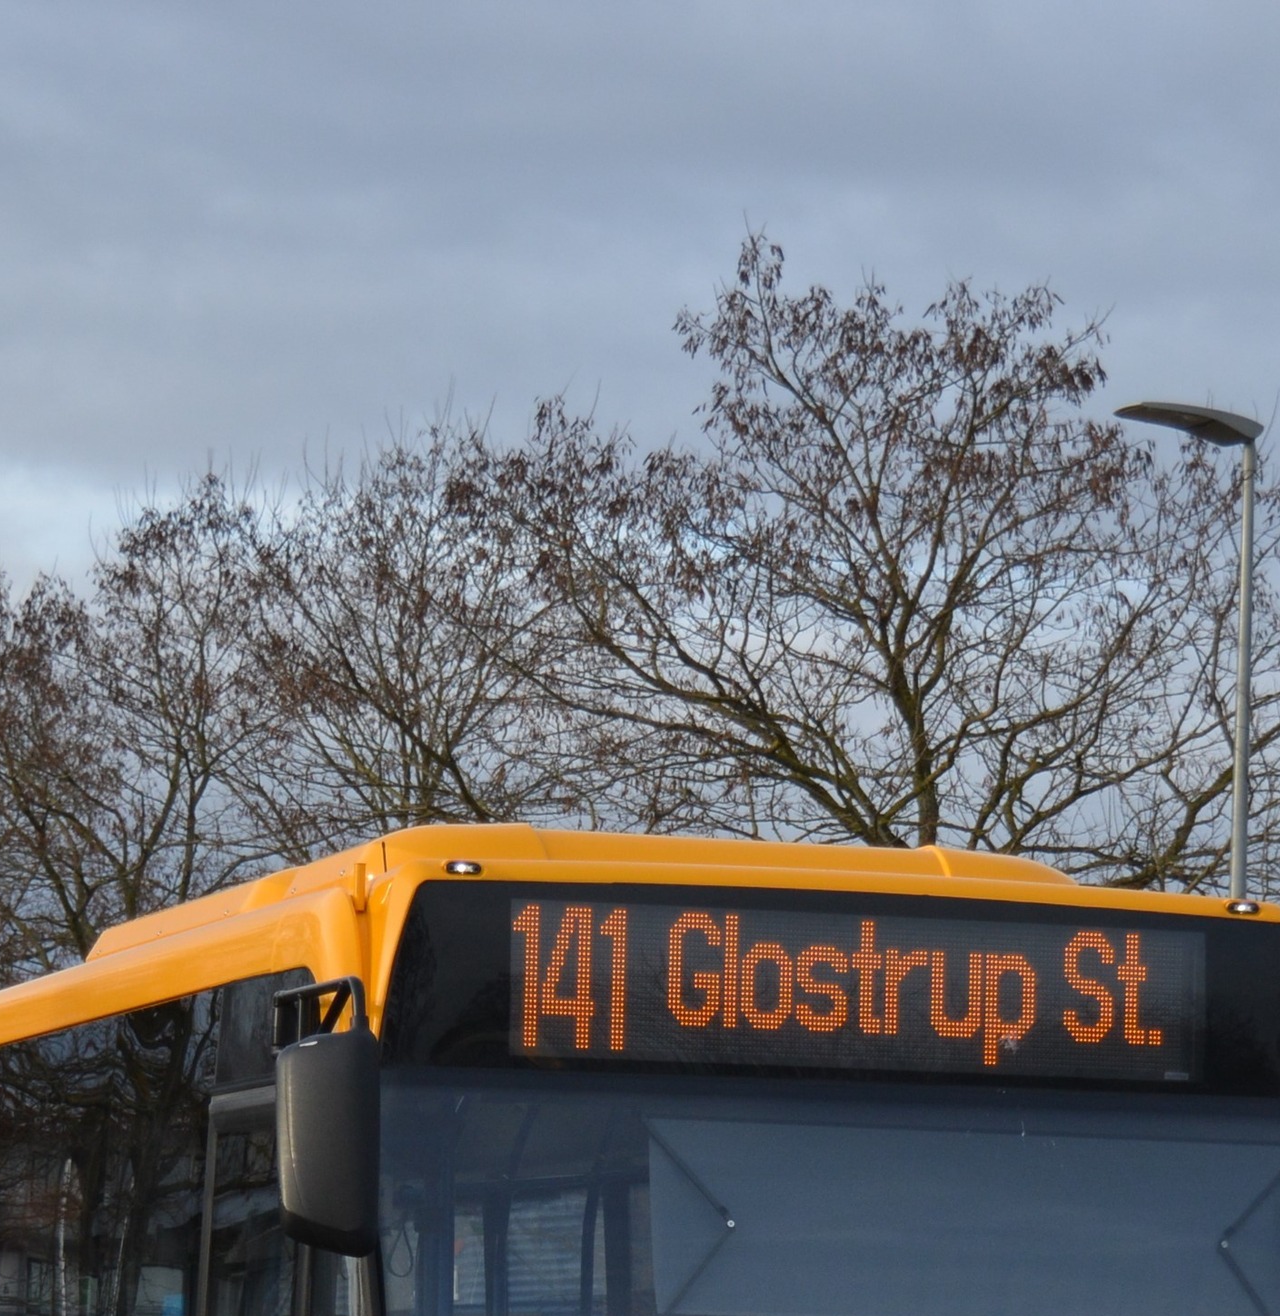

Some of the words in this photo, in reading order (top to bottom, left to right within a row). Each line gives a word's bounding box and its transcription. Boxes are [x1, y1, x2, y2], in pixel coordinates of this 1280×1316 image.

[512, 904, 629, 1051] 141
[667, 911, 1037, 1066] Glostrup
[1062, 930, 1163, 1046] St.
